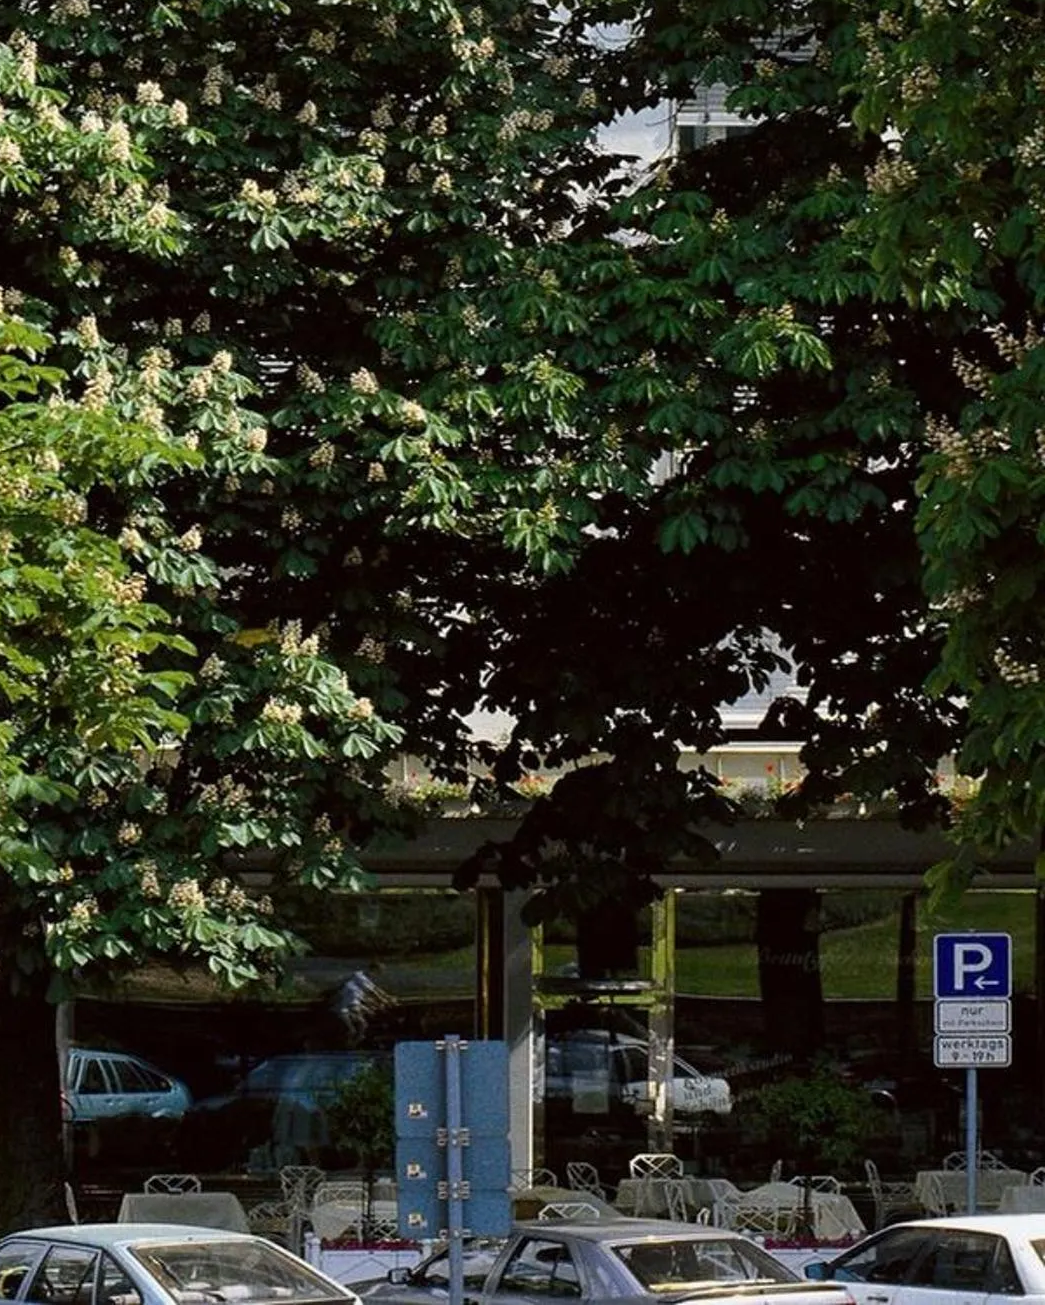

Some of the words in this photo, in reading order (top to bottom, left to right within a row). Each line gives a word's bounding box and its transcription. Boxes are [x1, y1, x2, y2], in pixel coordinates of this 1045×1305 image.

[954, 943, 992, 990] P
[961, 1007, 984, 1016] nur
[942, 1039, 1004, 1051] werktags
